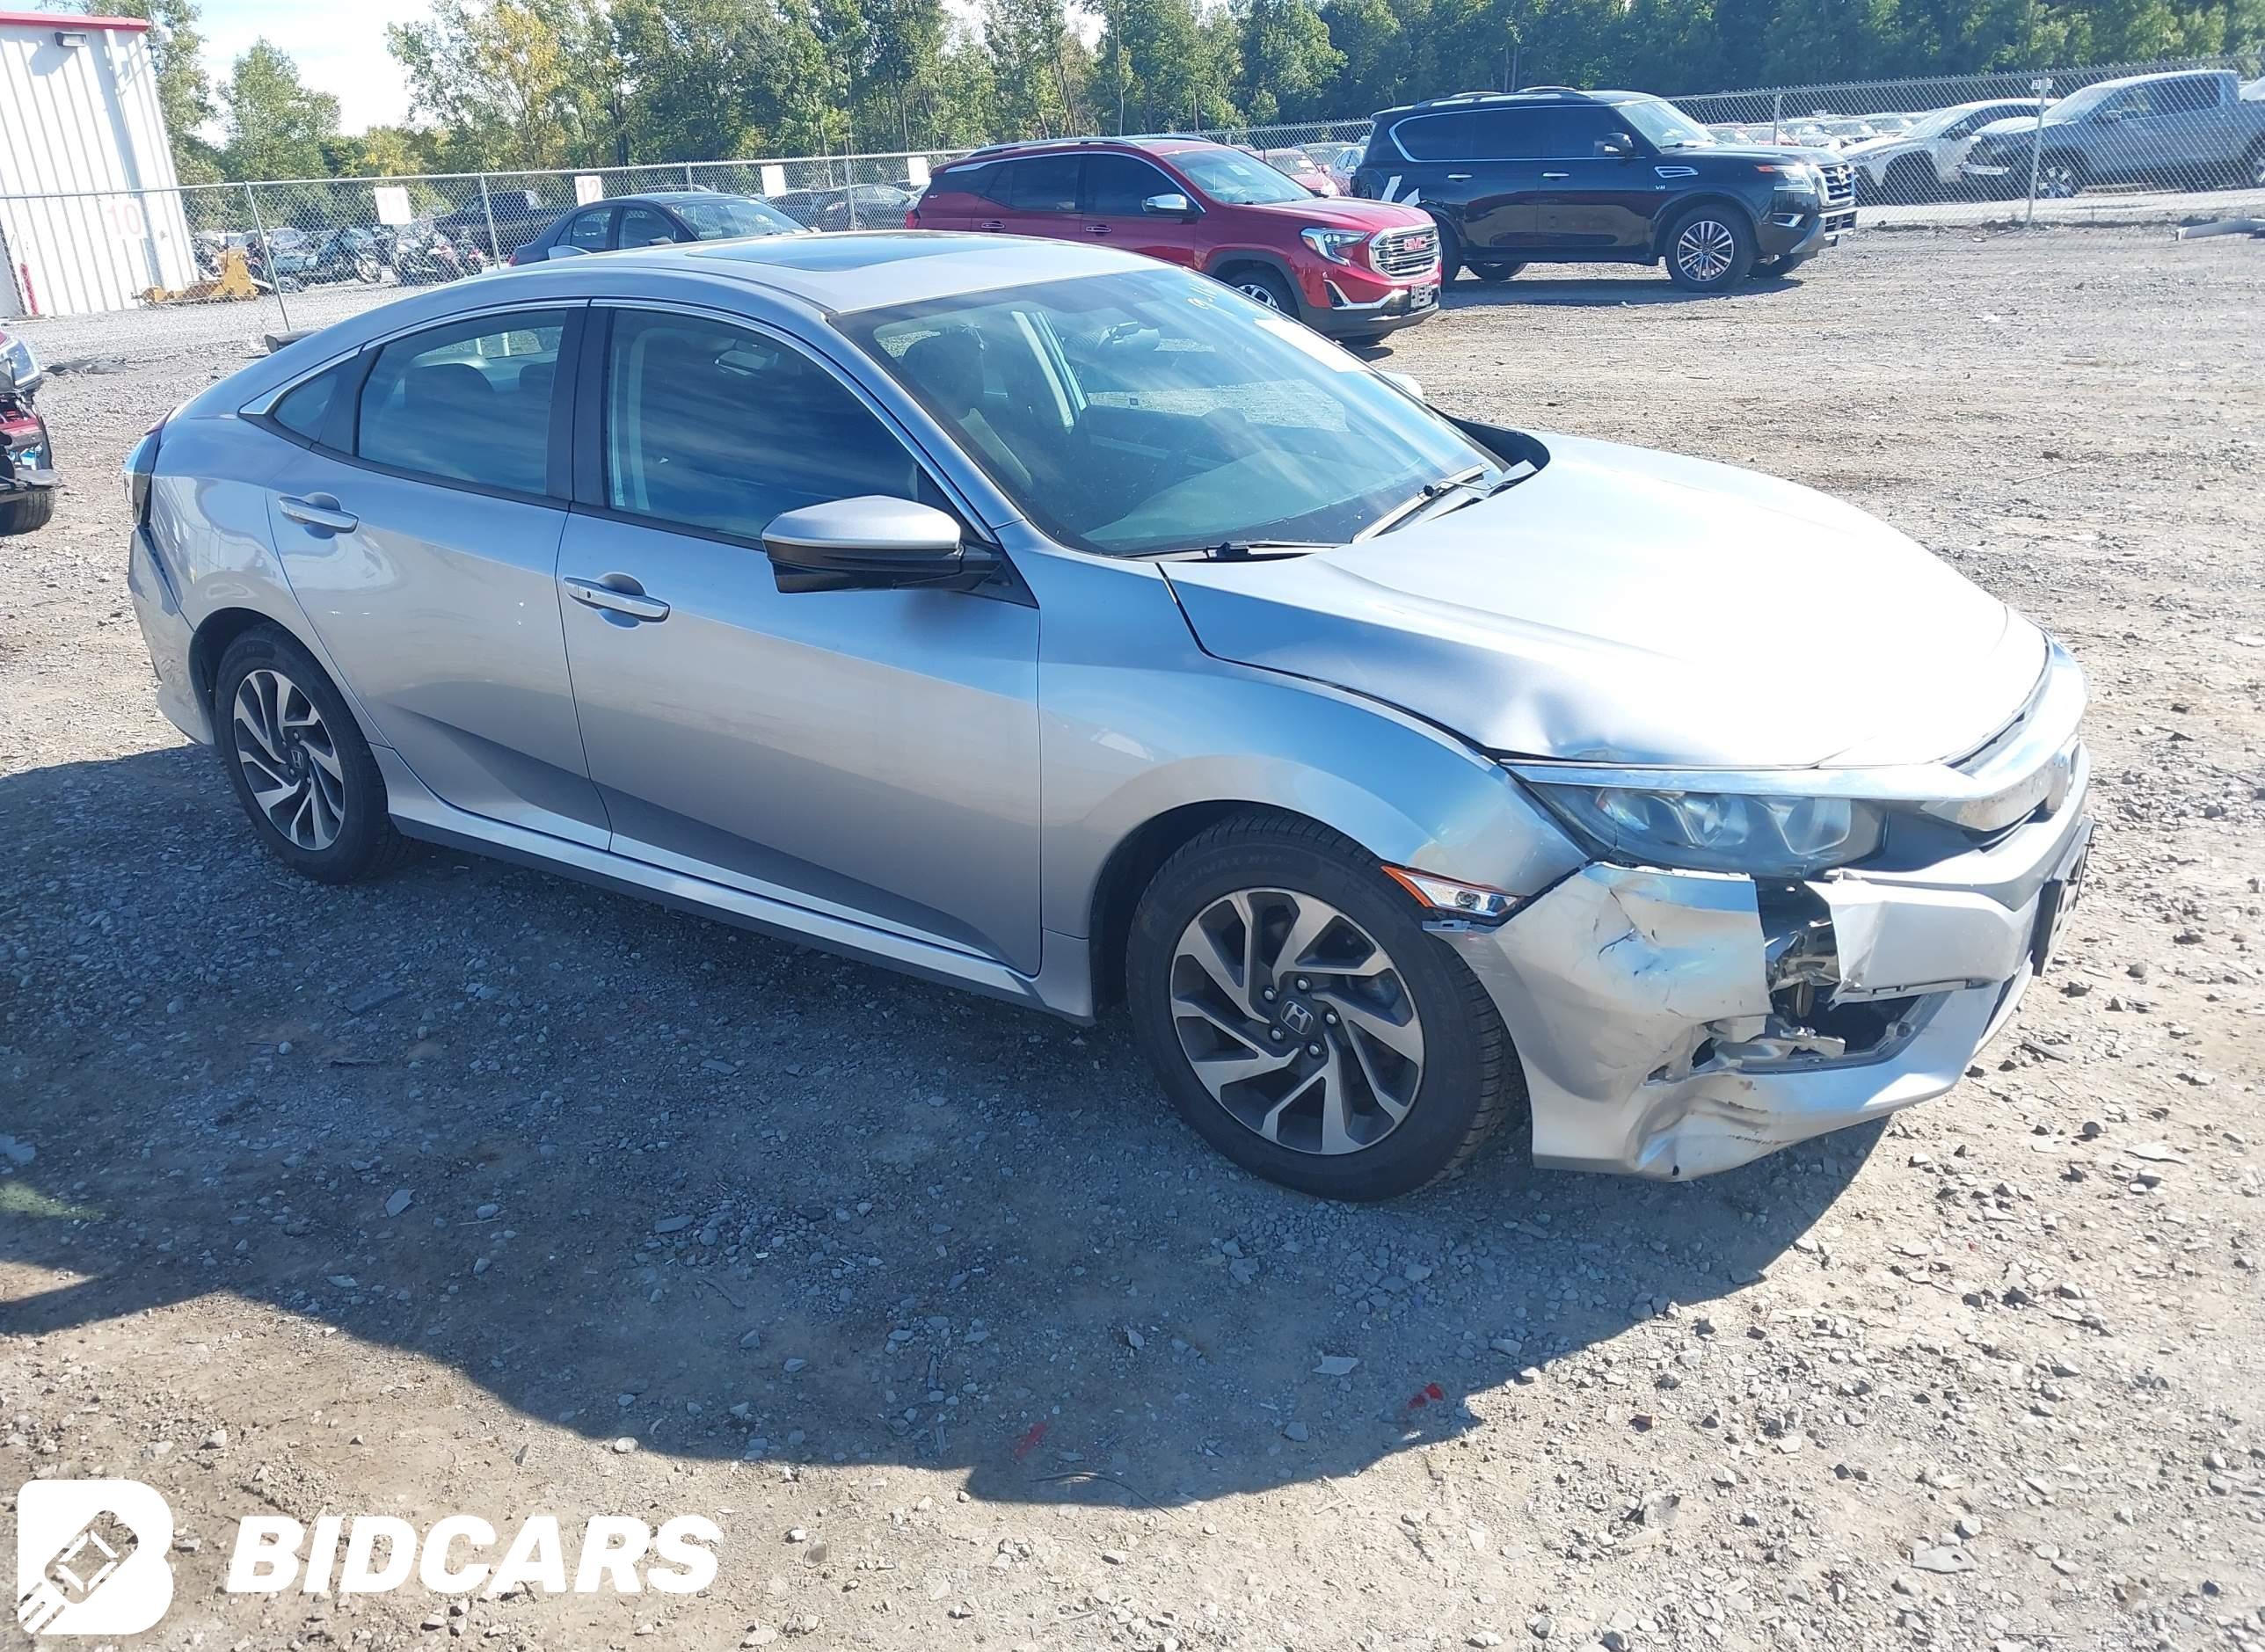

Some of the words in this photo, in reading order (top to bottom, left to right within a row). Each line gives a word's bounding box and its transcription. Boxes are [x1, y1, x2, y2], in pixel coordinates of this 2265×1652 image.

[578, 179, 600, 203] 12
[106, 203, 142, 235] 10
[1403, 236, 1427, 251] GMC
